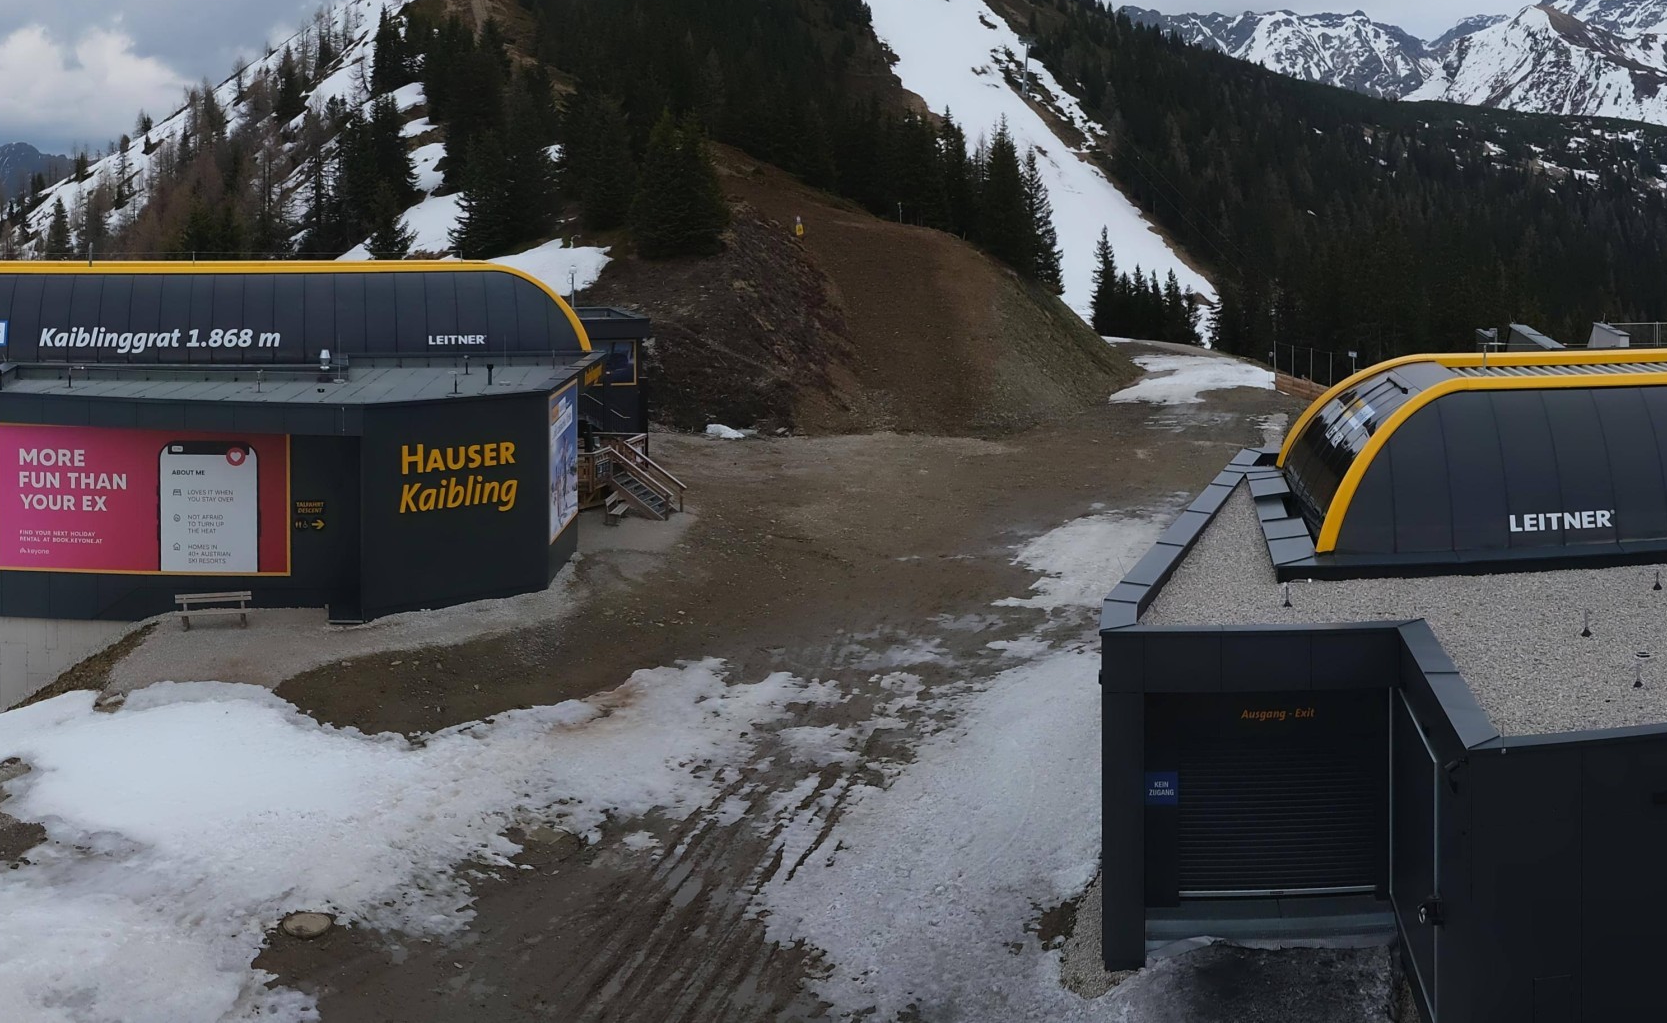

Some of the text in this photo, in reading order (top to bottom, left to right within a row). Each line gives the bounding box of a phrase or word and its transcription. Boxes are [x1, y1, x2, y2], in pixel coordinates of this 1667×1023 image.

[39, 327, 281, 353] Kaiblinggrat 1.868 m
[19, 448, 85, 467] MORE
[401, 441, 516, 475] HAUSER
[19, 472, 127, 490] FUN THAN
[20, 494, 107, 512] YOUR EX
[399, 475, 518, 514] Kaibling
[1241, 709, 1287, 721] Ausgang
[1294, 707, 1315, 718] Exit
[1148, 788, 1175, 796] ZUGANG
